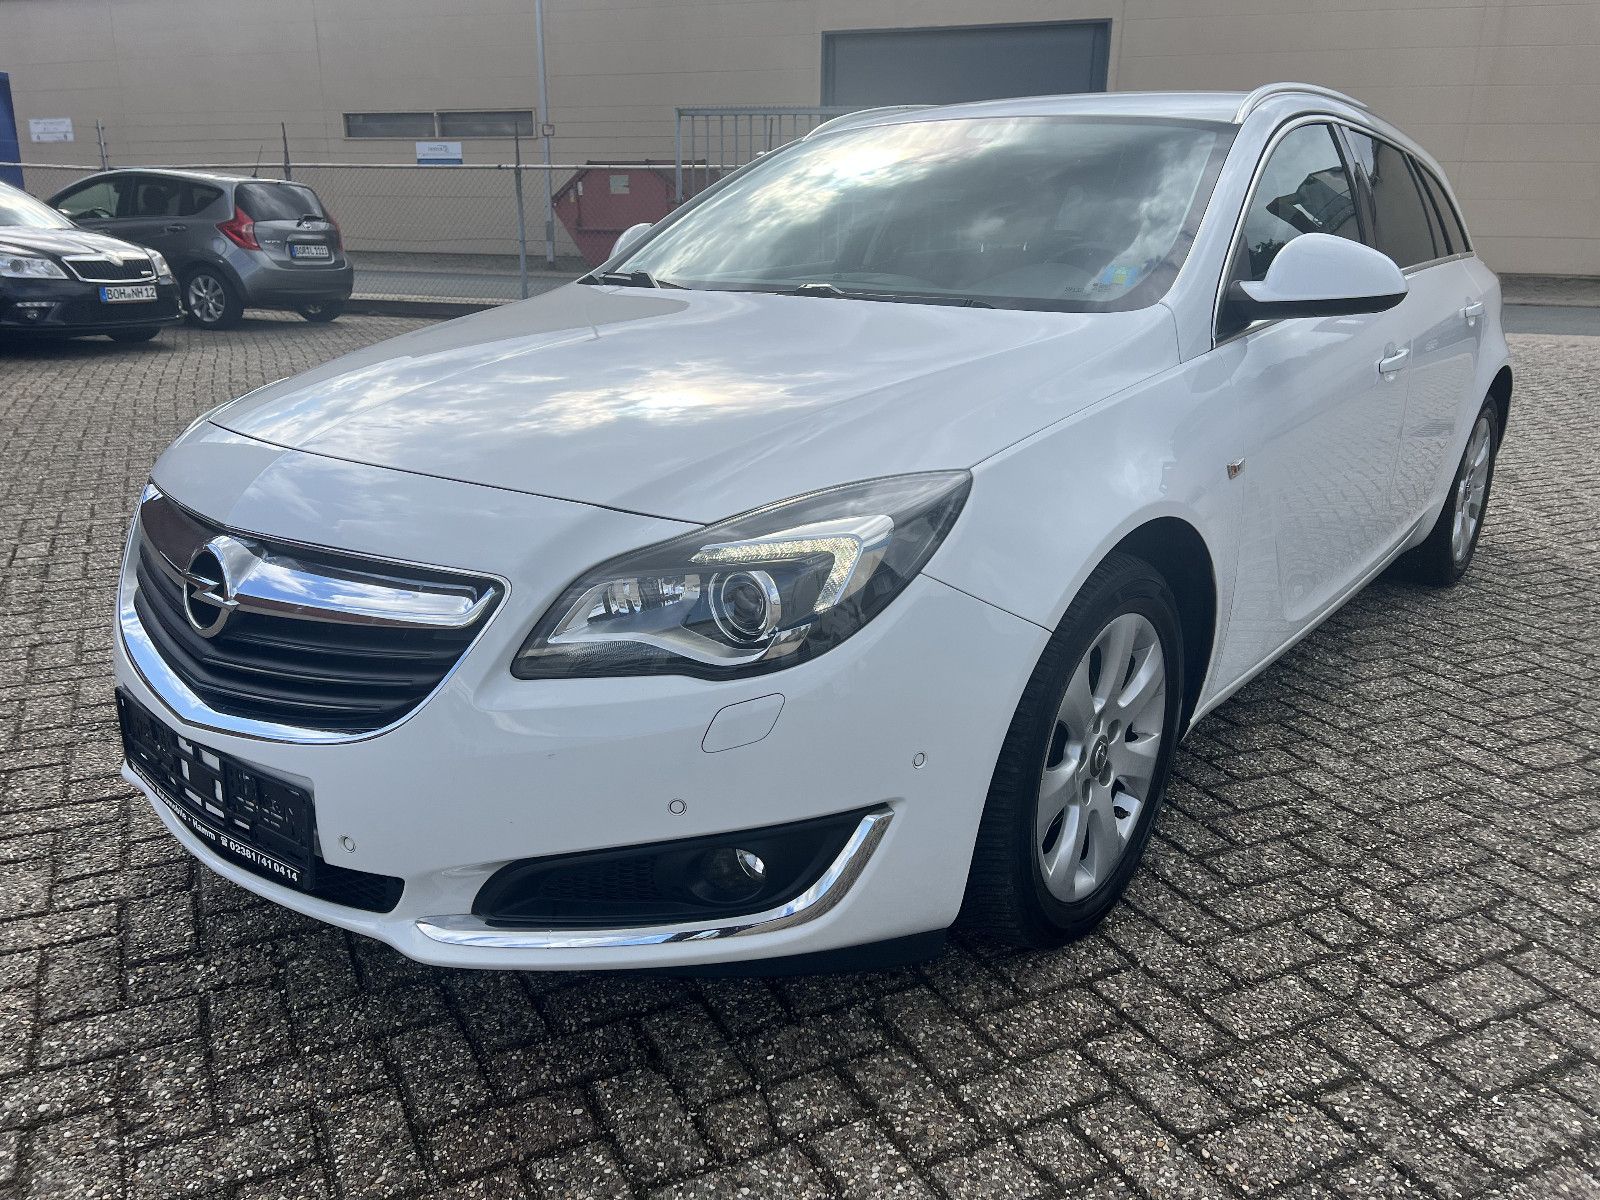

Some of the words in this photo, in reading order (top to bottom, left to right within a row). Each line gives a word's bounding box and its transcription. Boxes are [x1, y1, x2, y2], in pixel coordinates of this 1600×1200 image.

[106, 288, 127, 300] BOH
[144, 286, 156, 298] 12
[192, 818, 216, 841] Hamm
